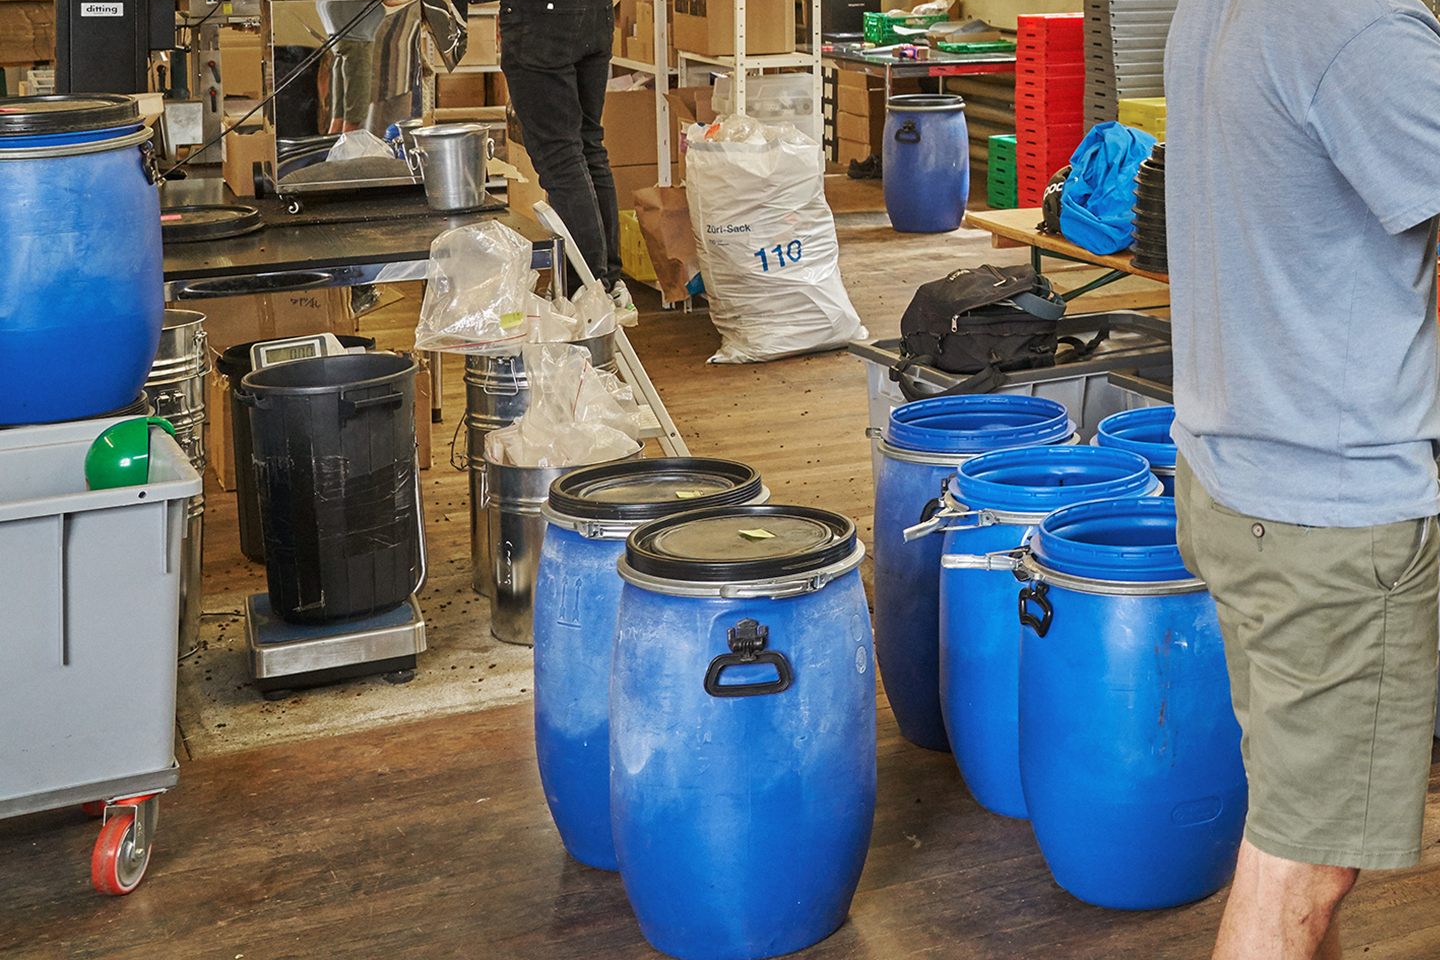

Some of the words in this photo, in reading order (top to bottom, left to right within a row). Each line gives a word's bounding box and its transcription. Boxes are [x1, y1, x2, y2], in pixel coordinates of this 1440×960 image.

[86, 5, 118, 14] ditting
[706, 223, 751, 234] Züri-Sack
[754, 239, 802, 272] 110
